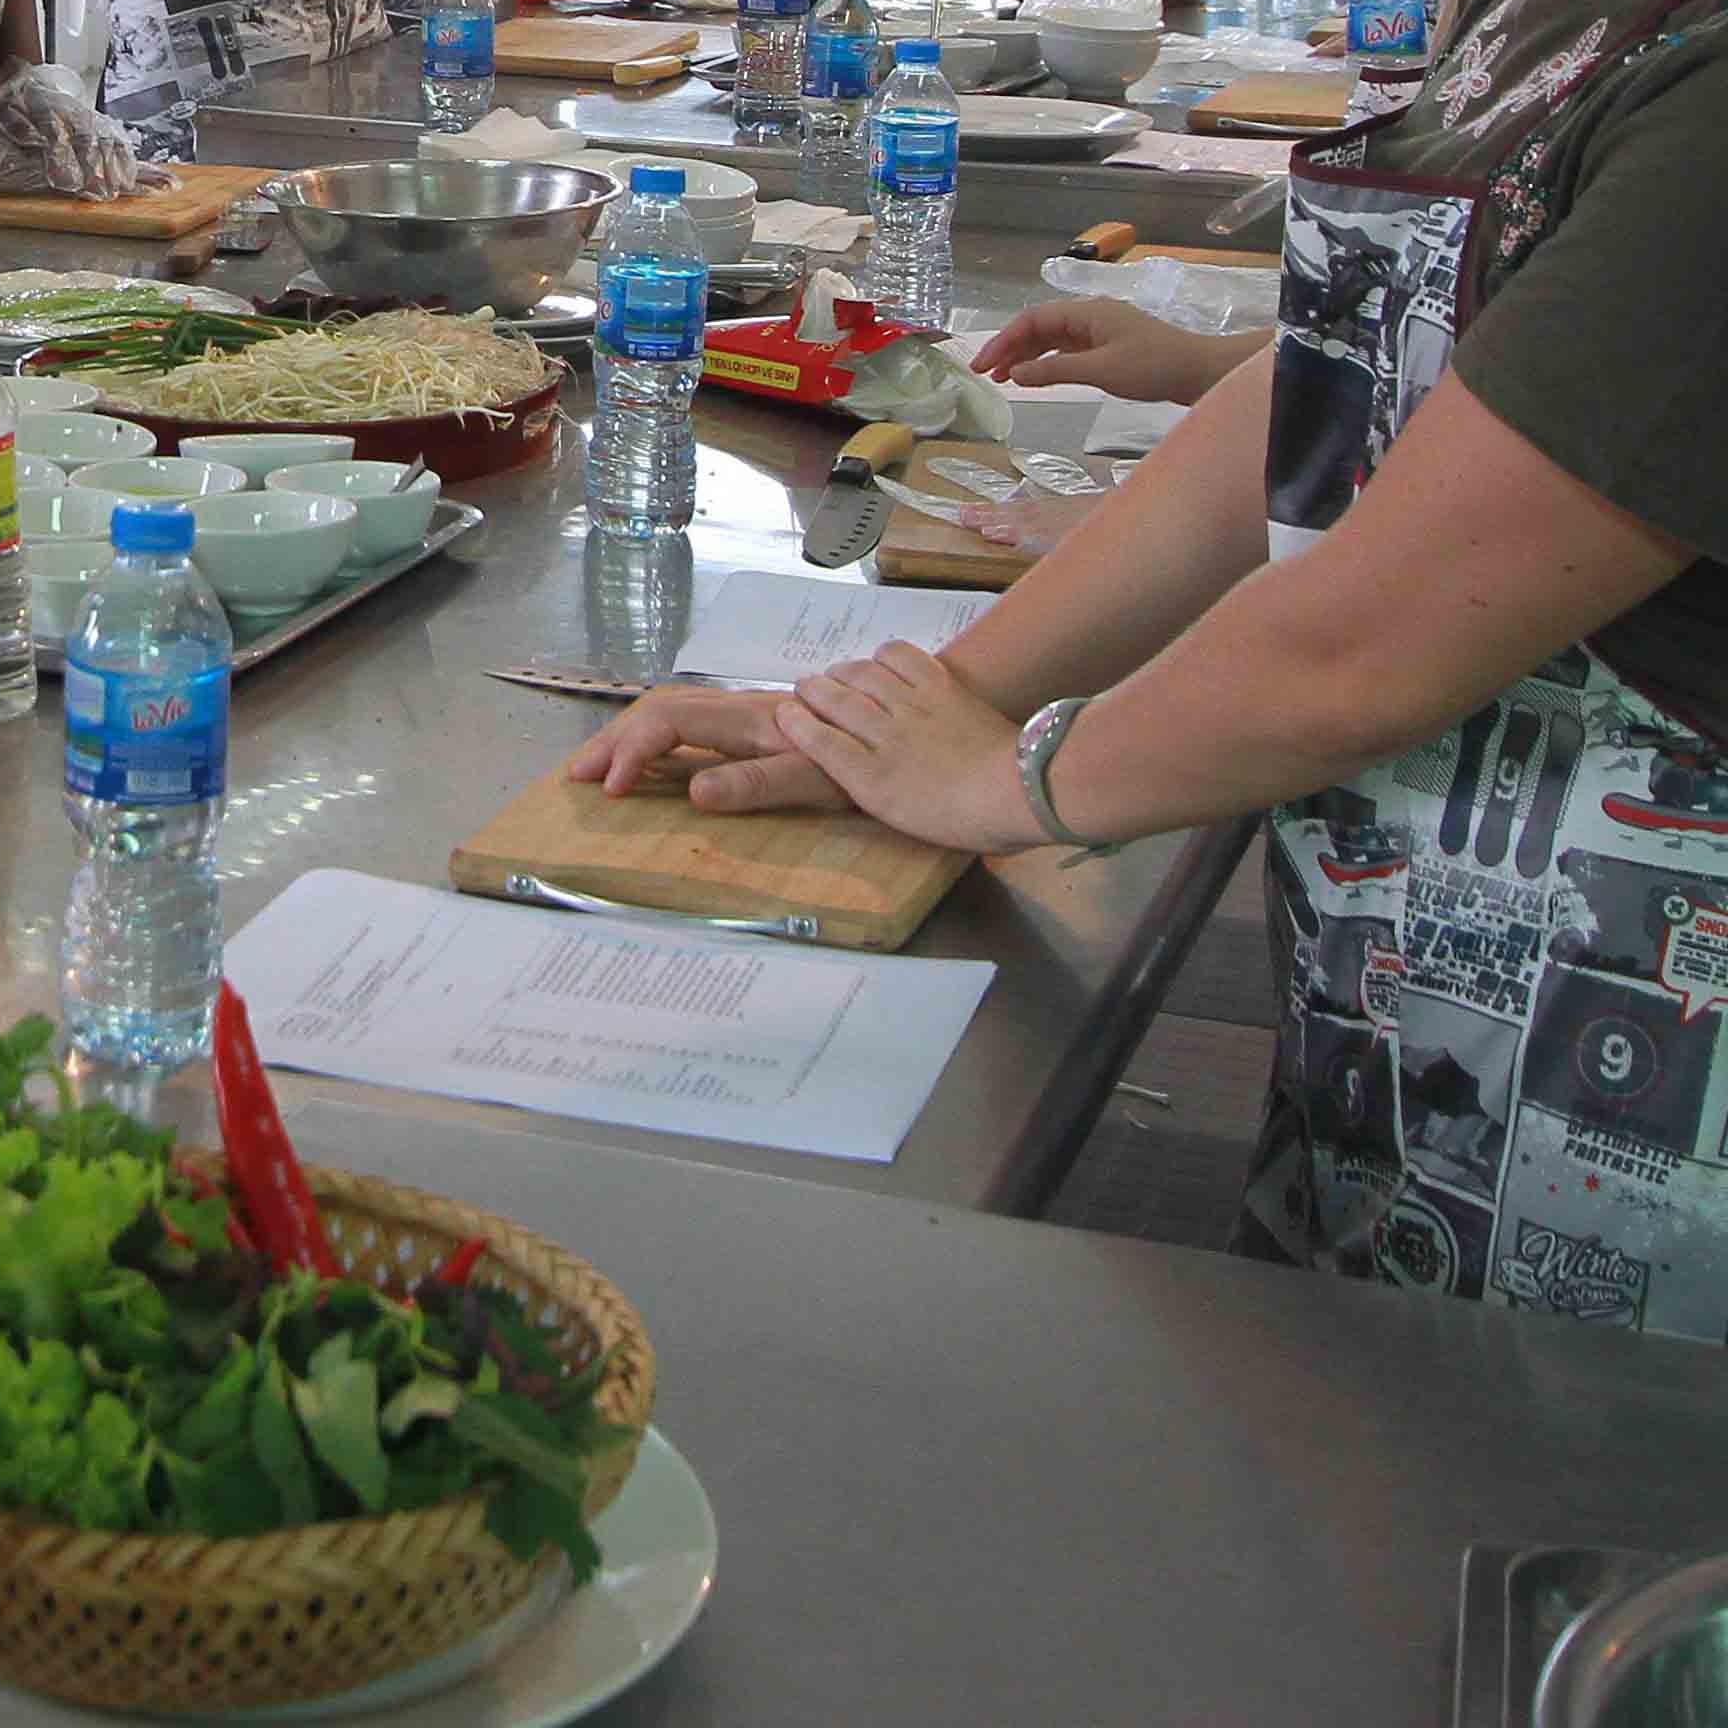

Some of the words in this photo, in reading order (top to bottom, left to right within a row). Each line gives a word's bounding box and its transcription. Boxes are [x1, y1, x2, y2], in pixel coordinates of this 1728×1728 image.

[1599, 1033, 1633, 1081] 9
[1562, 1139, 1669, 1185] FANTASTIC
[1521, 1228, 1643, 1288] Winter
